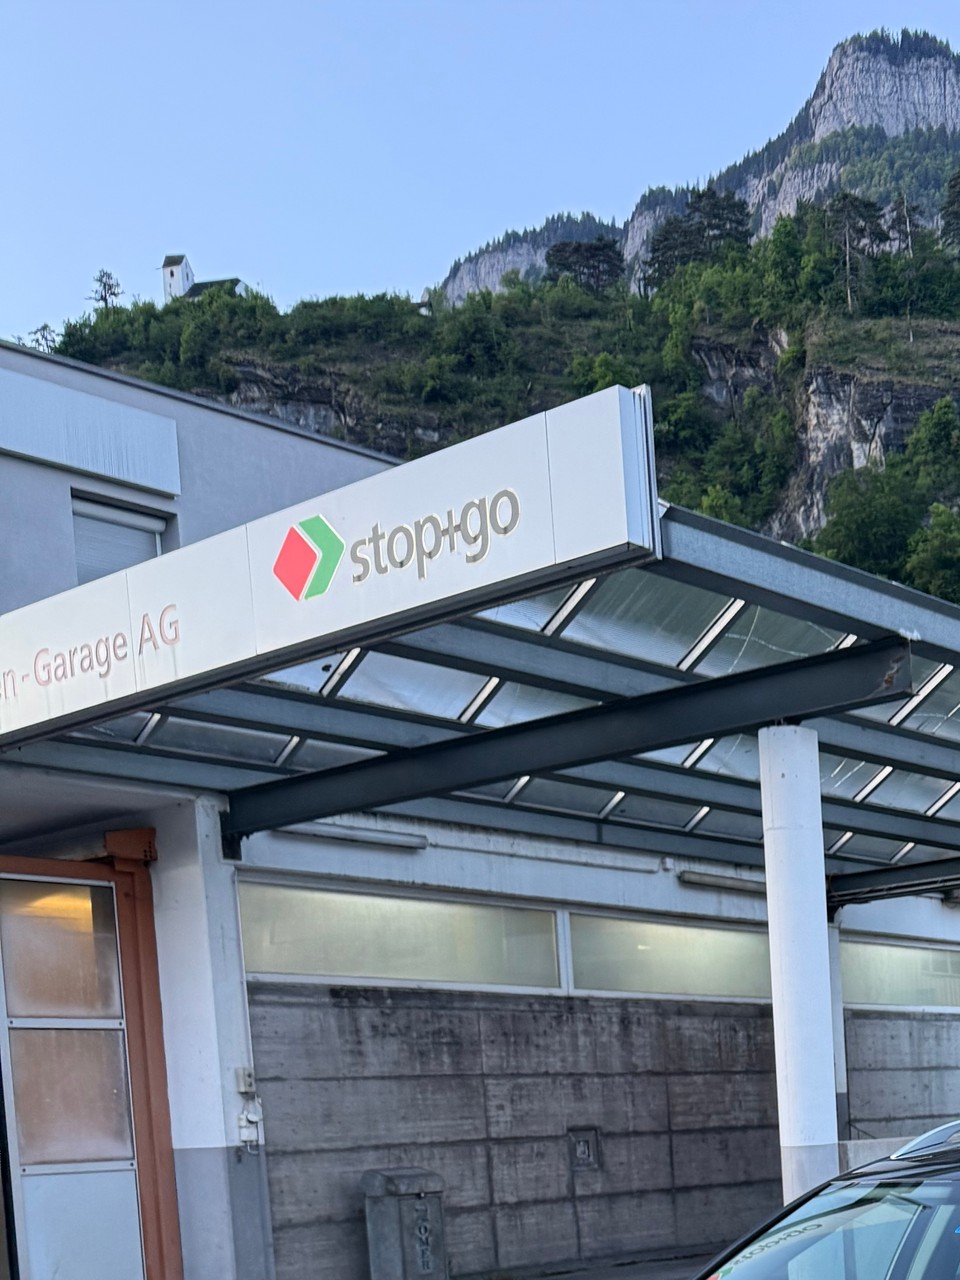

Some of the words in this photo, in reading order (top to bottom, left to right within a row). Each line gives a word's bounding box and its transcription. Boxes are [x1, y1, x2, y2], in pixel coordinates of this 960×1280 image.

[350, 488, 521, 584] stop+go
[0, 631, 128, 700] n-Garage
[138, 603, 181, 657] AG
